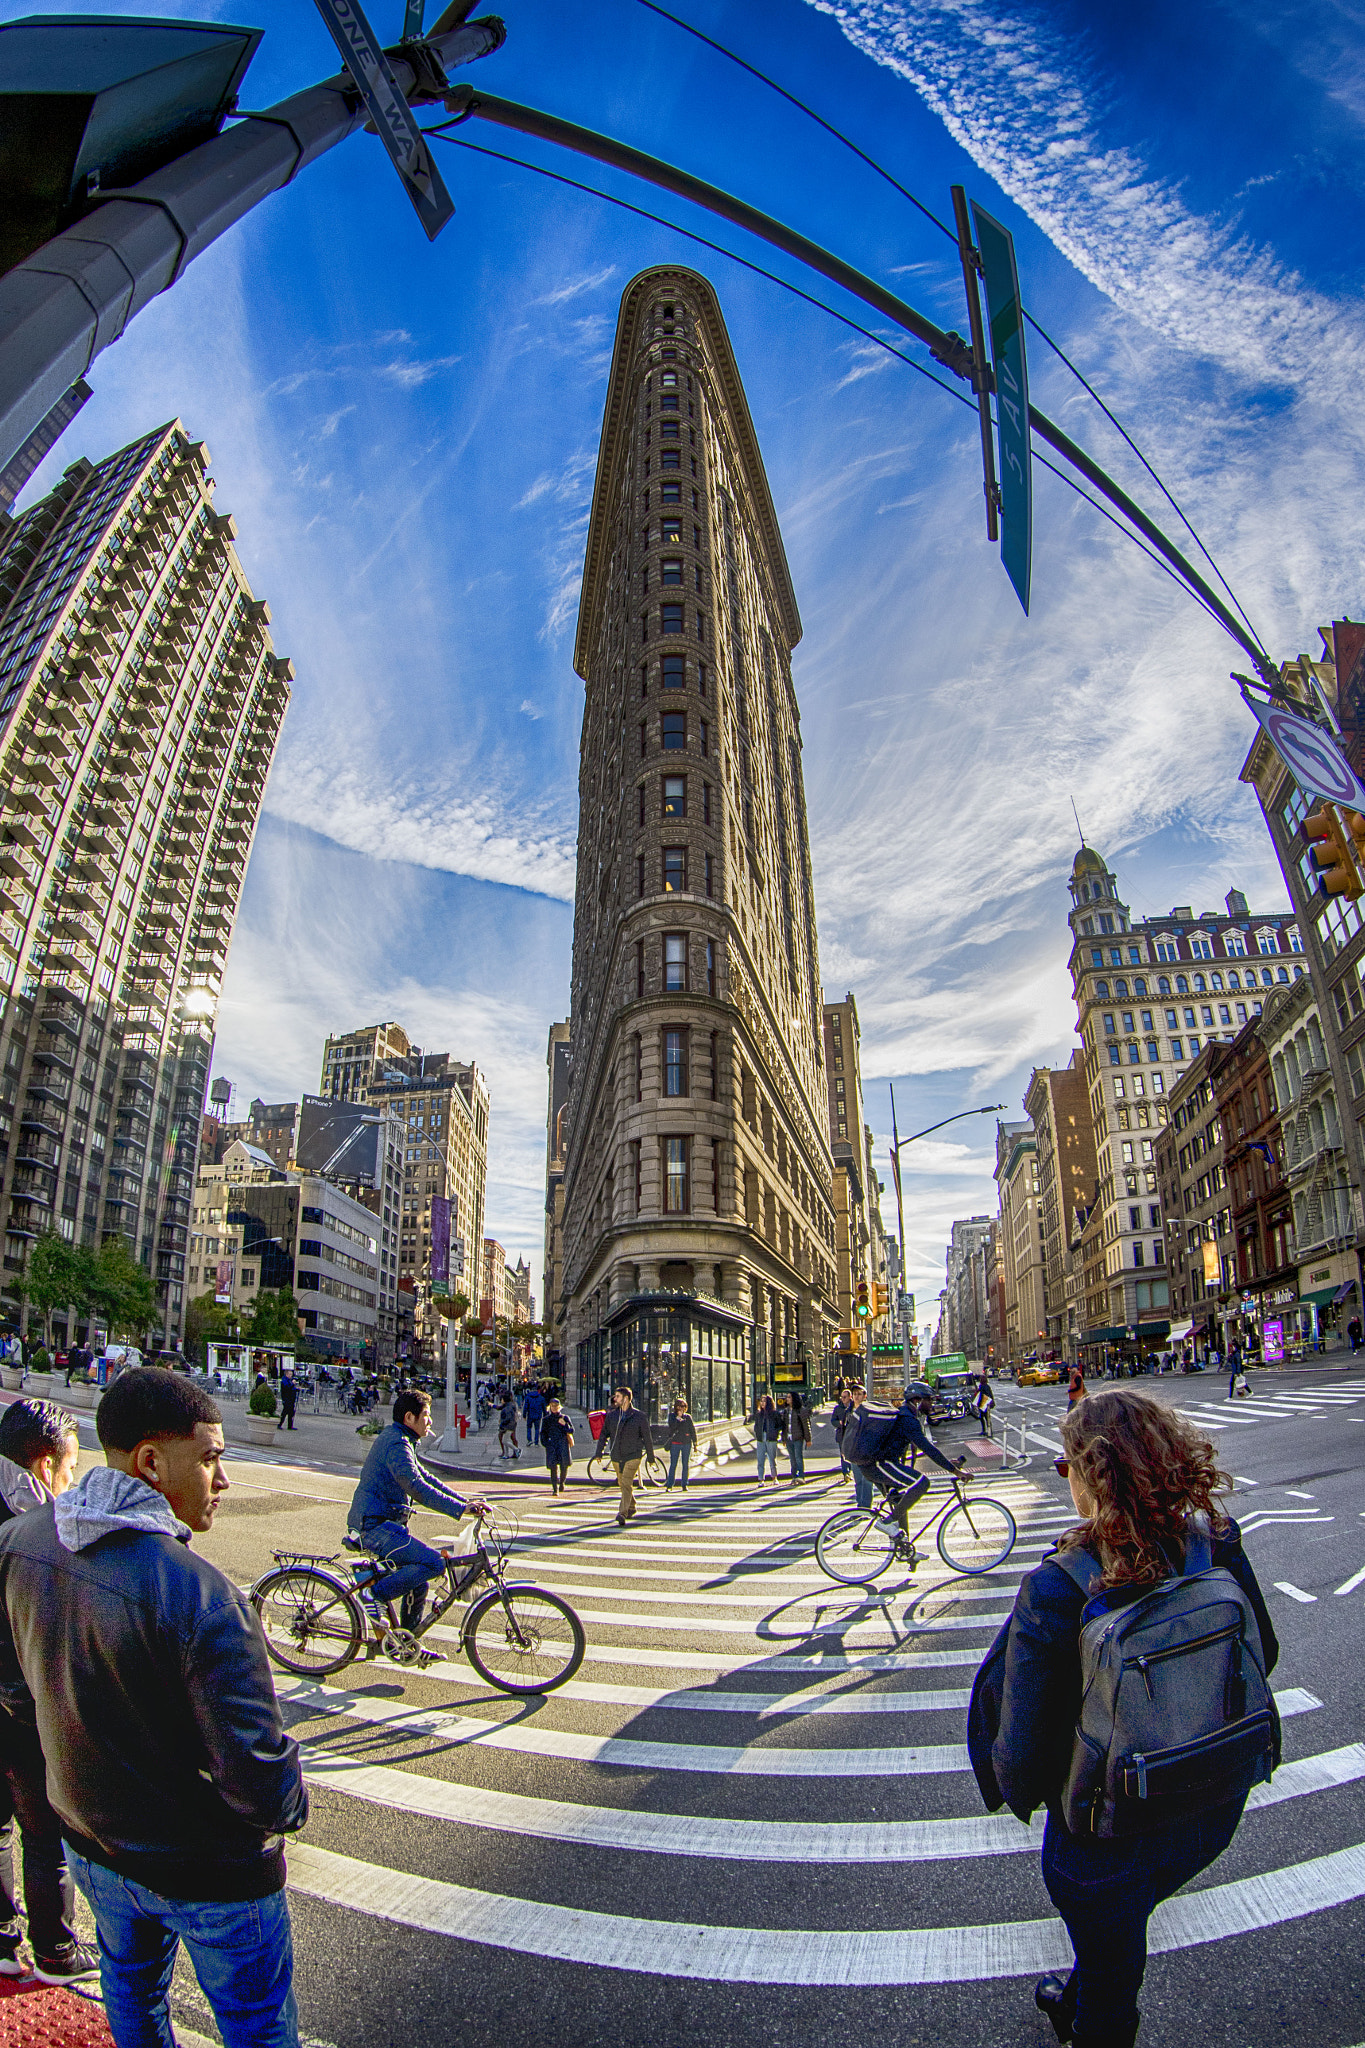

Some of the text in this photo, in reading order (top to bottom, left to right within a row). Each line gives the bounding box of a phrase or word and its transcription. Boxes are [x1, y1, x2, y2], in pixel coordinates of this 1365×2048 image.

[333, 0, 430, 178] ONE WAY
[1002, 360, 1022, 438] AV
[311, 1098, 328, 1108] iPhone
